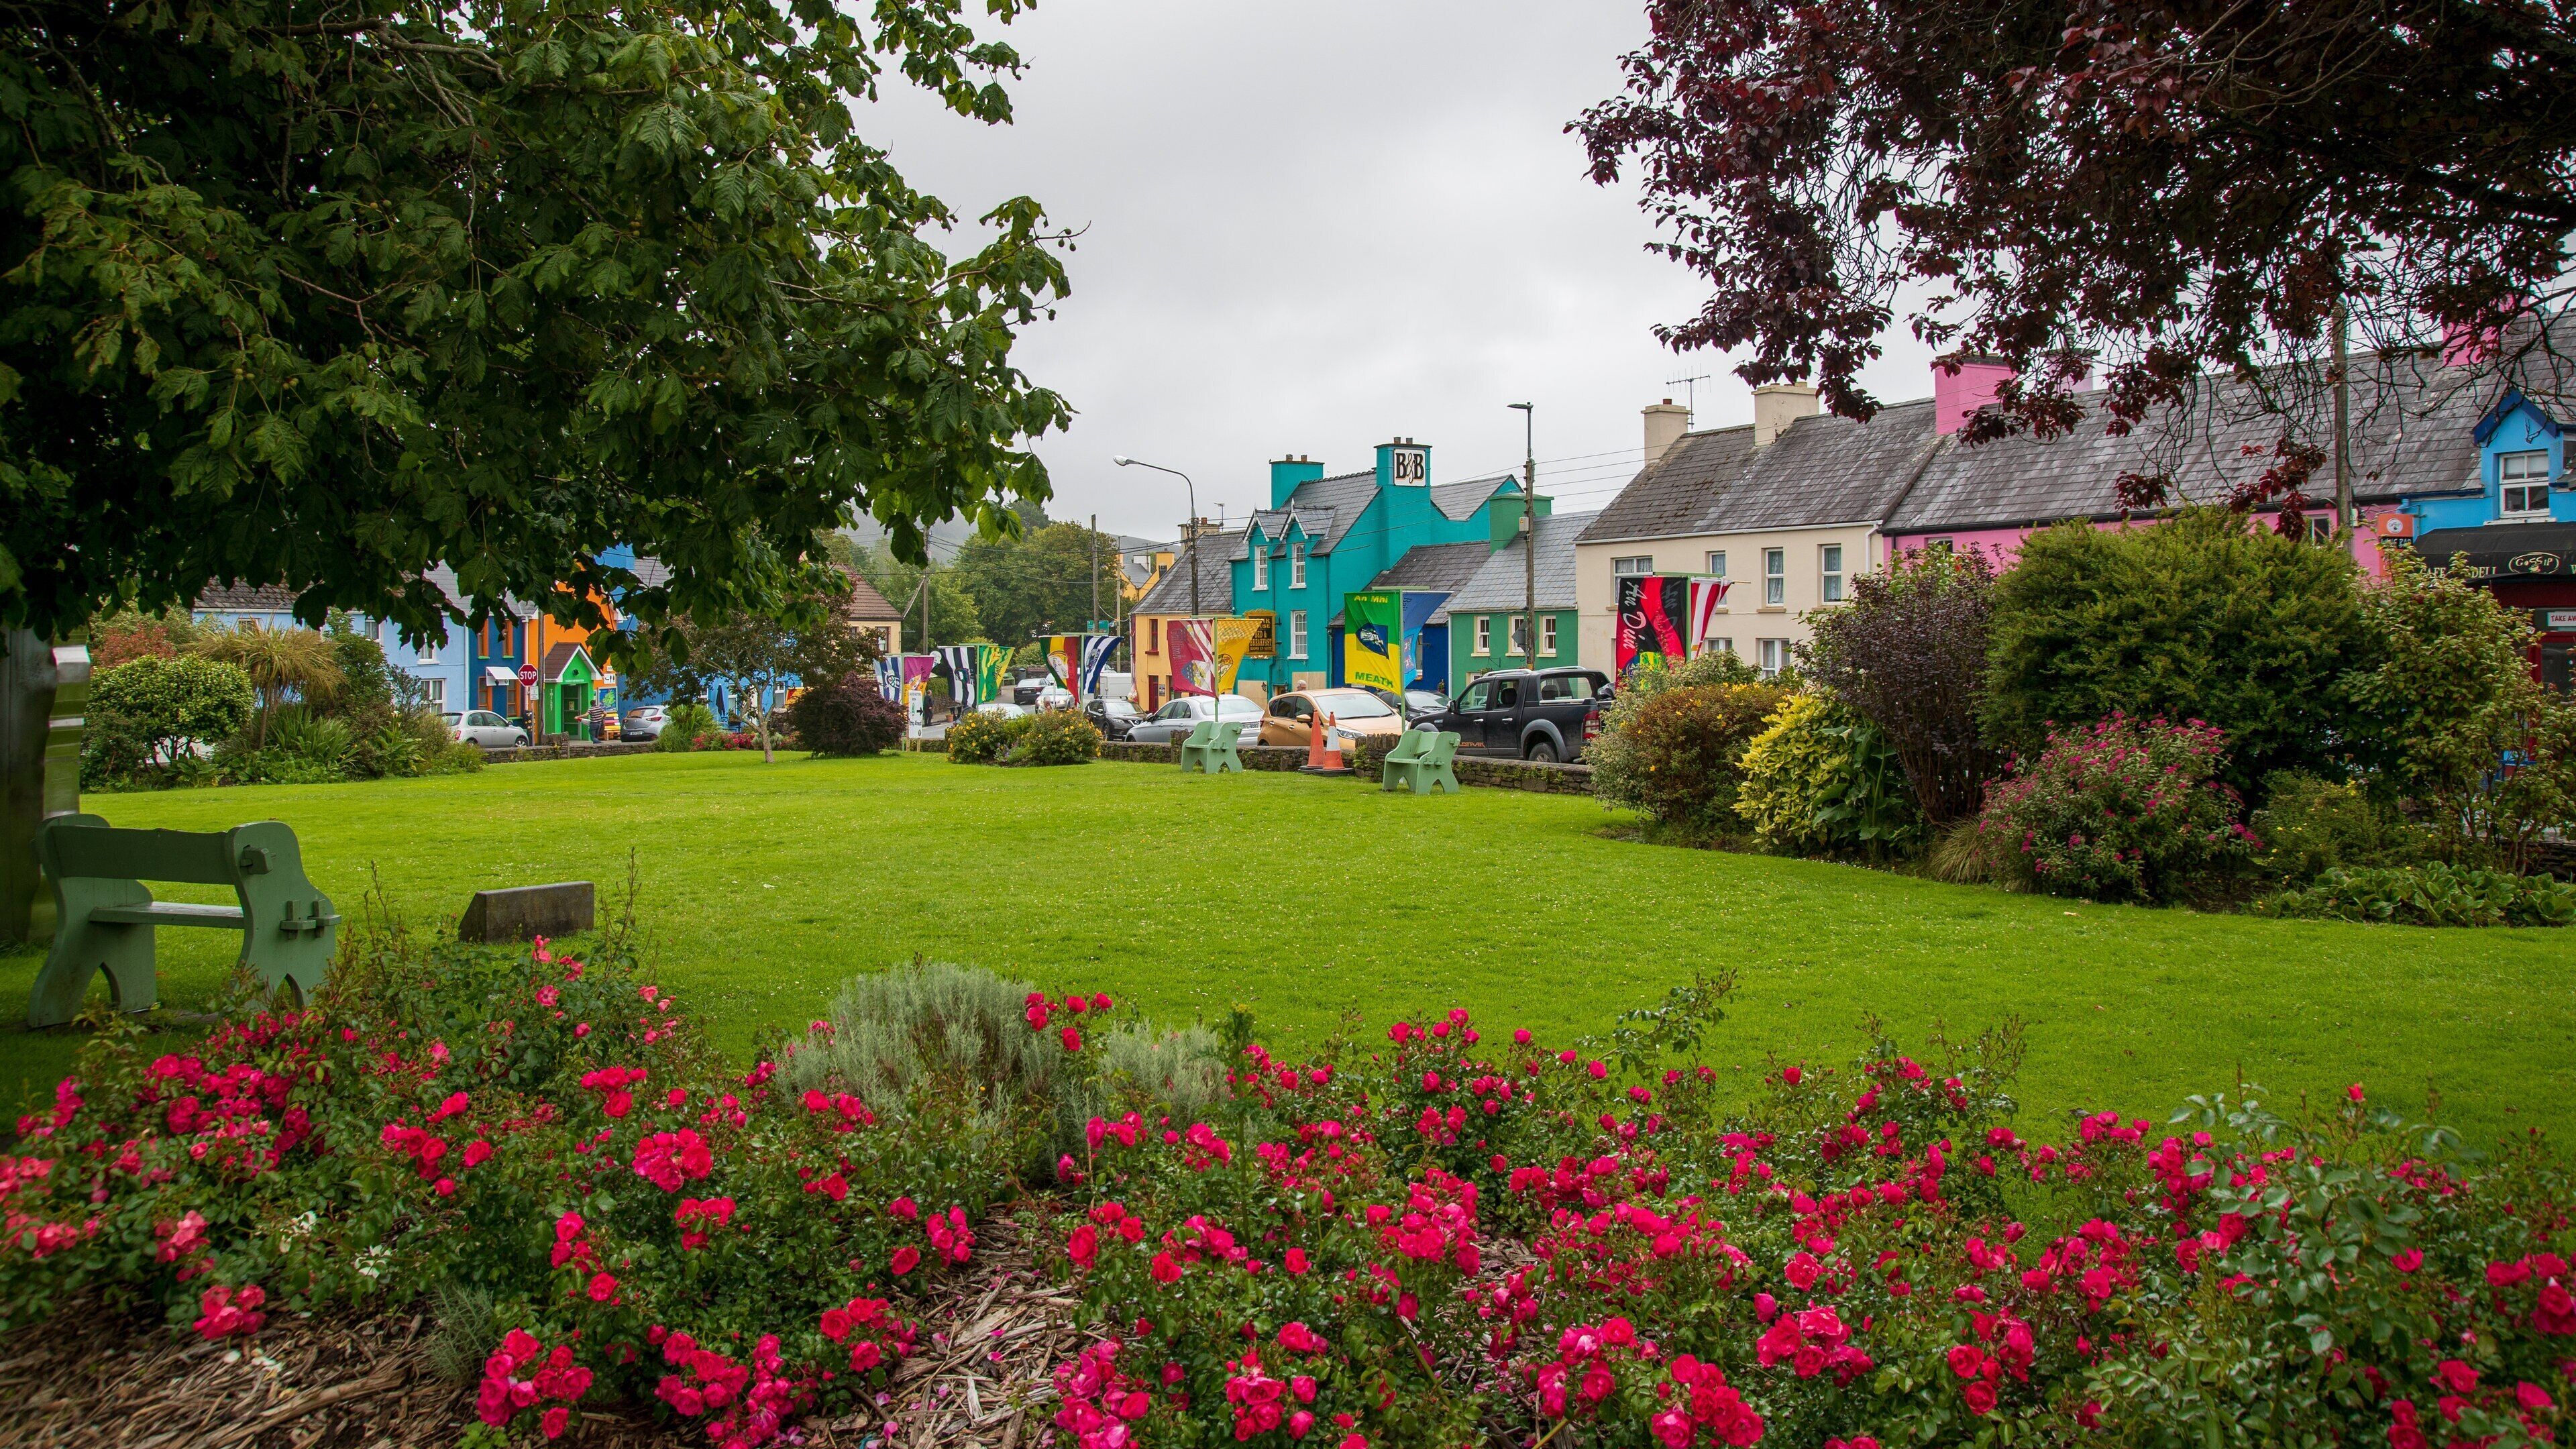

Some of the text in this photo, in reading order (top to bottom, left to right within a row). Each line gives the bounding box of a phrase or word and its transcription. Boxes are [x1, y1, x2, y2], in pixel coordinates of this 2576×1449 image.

[1396, 453, 1424, 483] B&B
[520, 671, 537, 680] STOP
[1355, 672, 1393, 688] MEATH
